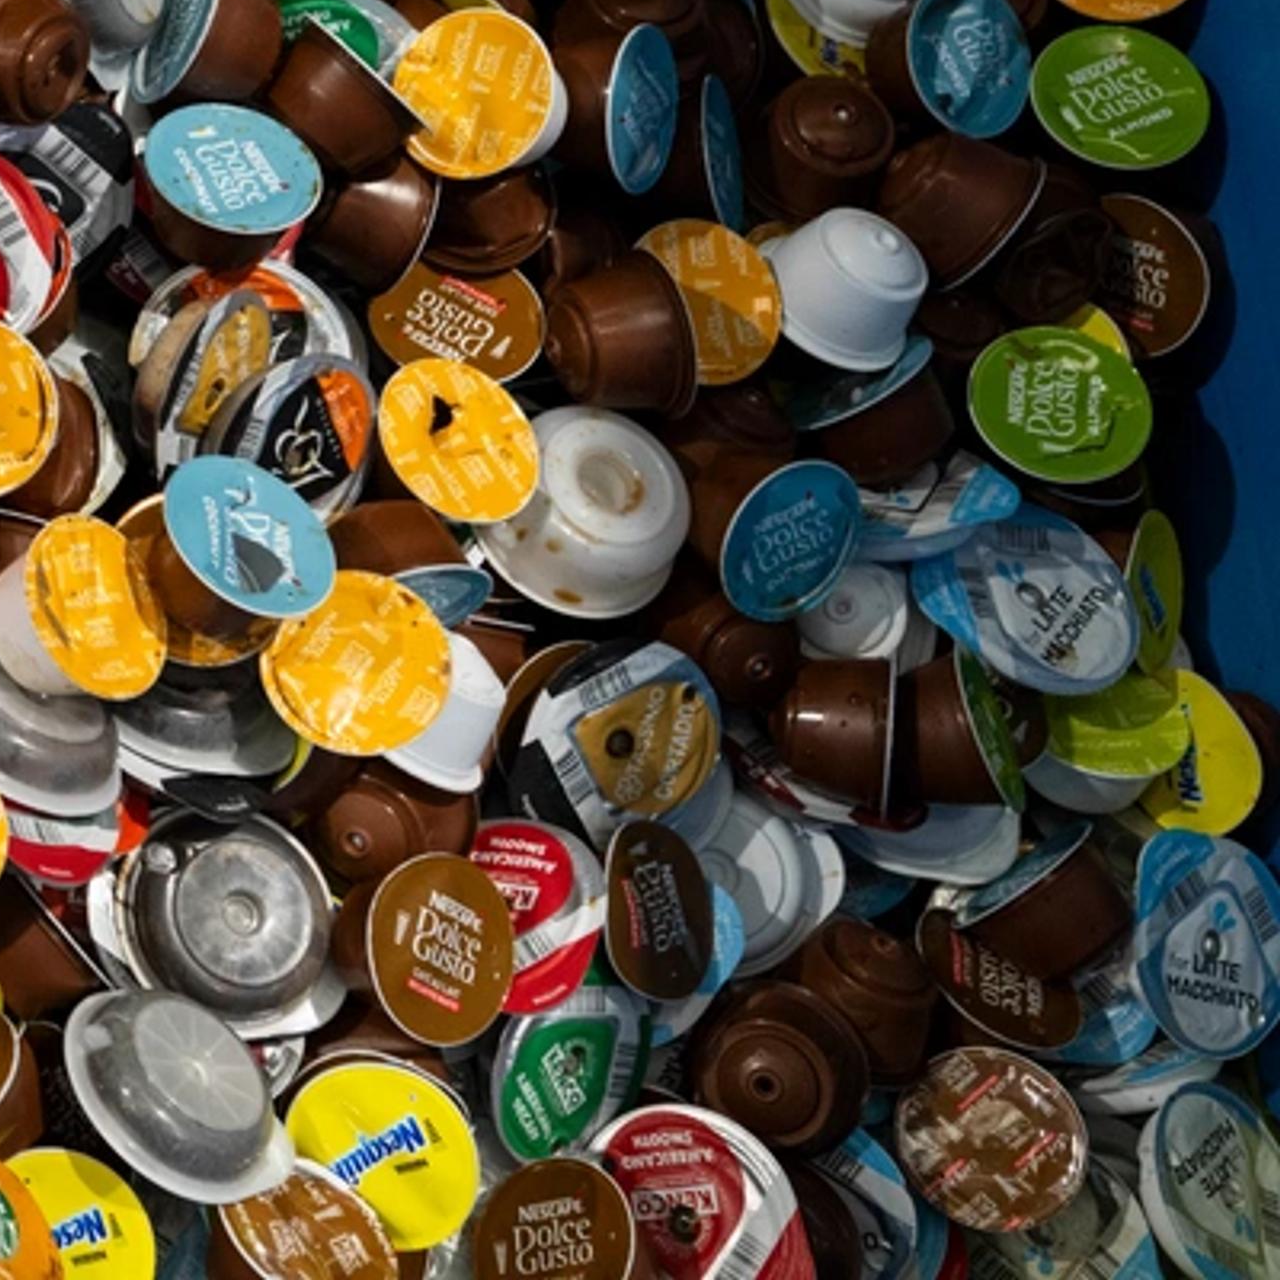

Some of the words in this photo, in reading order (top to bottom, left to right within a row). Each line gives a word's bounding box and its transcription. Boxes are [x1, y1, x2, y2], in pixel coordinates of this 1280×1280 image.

[1071, 68, 1148, 110] Dolce
[1087, 84, 1162, 120] Gusto
[1109, 110, 1172, 138] ALMOND
[199, 145, 243, 209] Gusto
[217, 140, 268, 204] Dolce
[408, 306, 485, 354] Dolce
[419, 291, 493, 337] Gusto
[1039, 587, 1074, 632] LATTE
[1042, 588, 1108, 661] MACCHIATO
[472, 853, 557, 873] AMERICANO
[490, 838, 546, 853] SMOOTH
[418, 909, 481, 956] Dolce
[416, 935, 475, 983] Gusto
[1194, 954, 1239, 981] LATTE
[1168, 977, 1259, 1010] MACCHIATO
[633, 1131, 694, 1148] SMOOTH
[622, 1147, 714, 1171] AMERICANO
[515, 1218, 588, 1248] Dolce
[516, 1241, 594, 1274] Gusto
